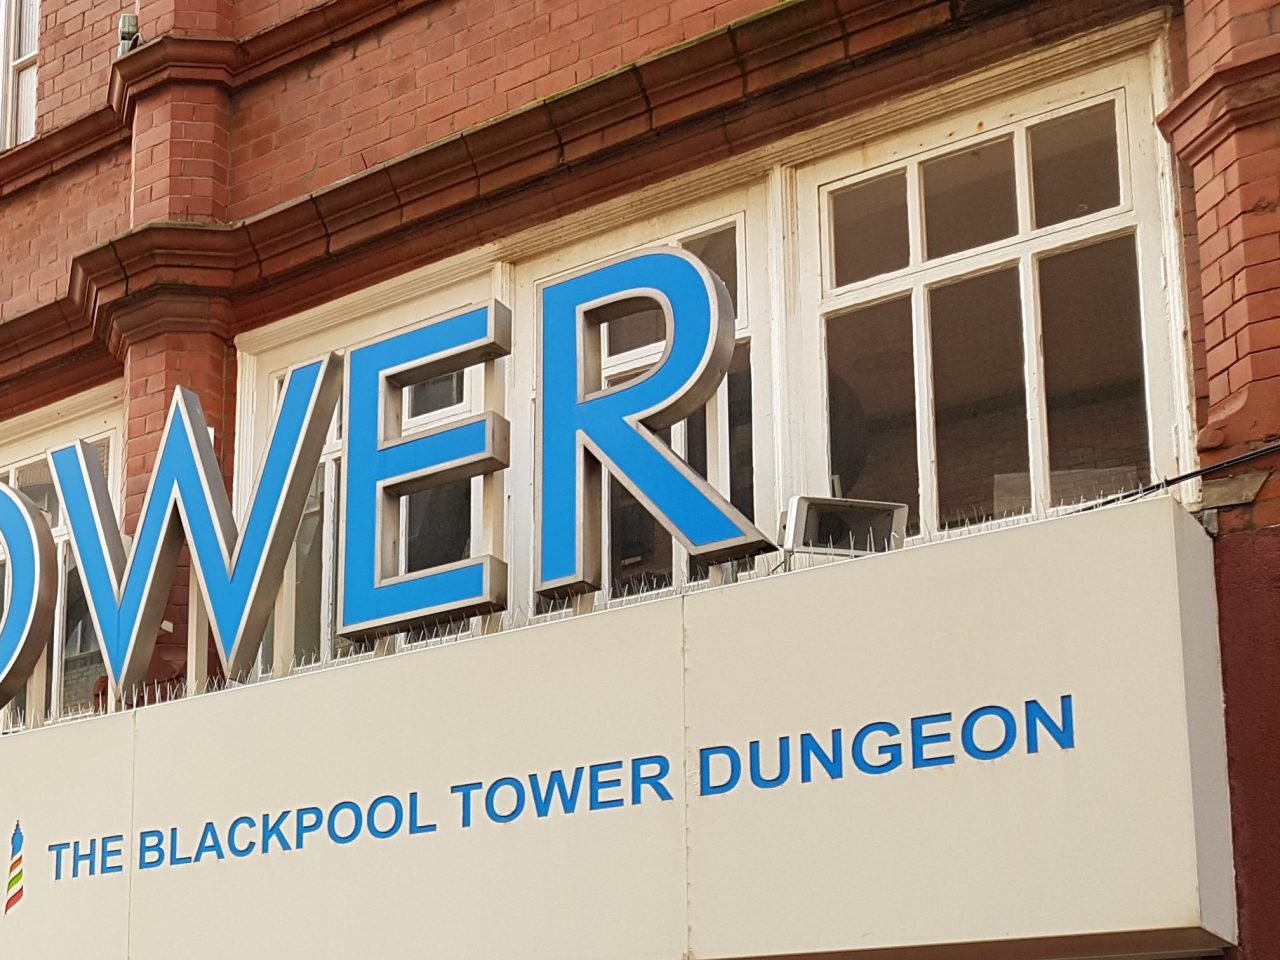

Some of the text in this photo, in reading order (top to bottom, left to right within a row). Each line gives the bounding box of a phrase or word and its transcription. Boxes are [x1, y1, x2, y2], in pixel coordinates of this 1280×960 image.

[48, 693, 1075, 880] THE BLACKPOOL TOWER DUNGEON
